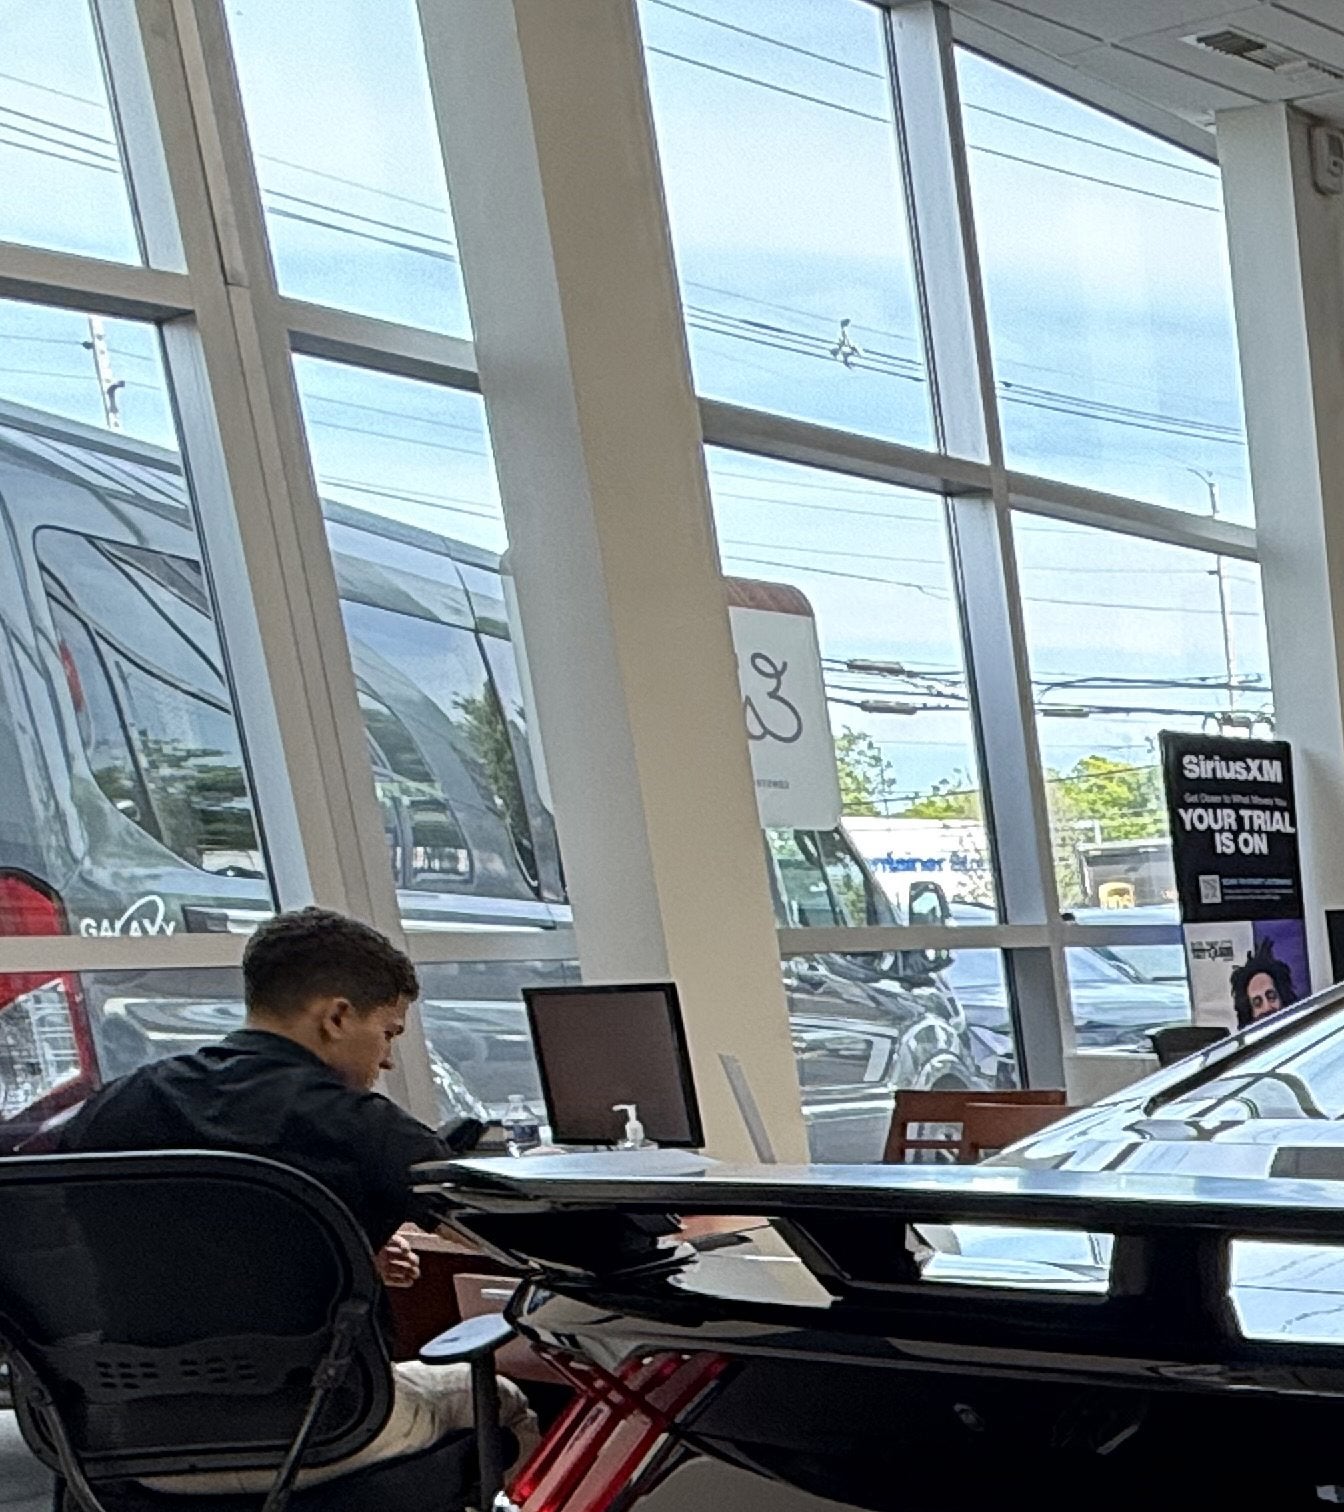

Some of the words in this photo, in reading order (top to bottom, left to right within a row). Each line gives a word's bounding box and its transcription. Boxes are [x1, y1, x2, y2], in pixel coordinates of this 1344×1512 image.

[1182, 755, 1283, 783] SiriusXM
[1178, 808, 1238, 832] YOUR
[1239, 809, 1296, 834] TRIAL
[1215, 833, 1235, 855] IS
[1237, 833, 1269, 856] ON
